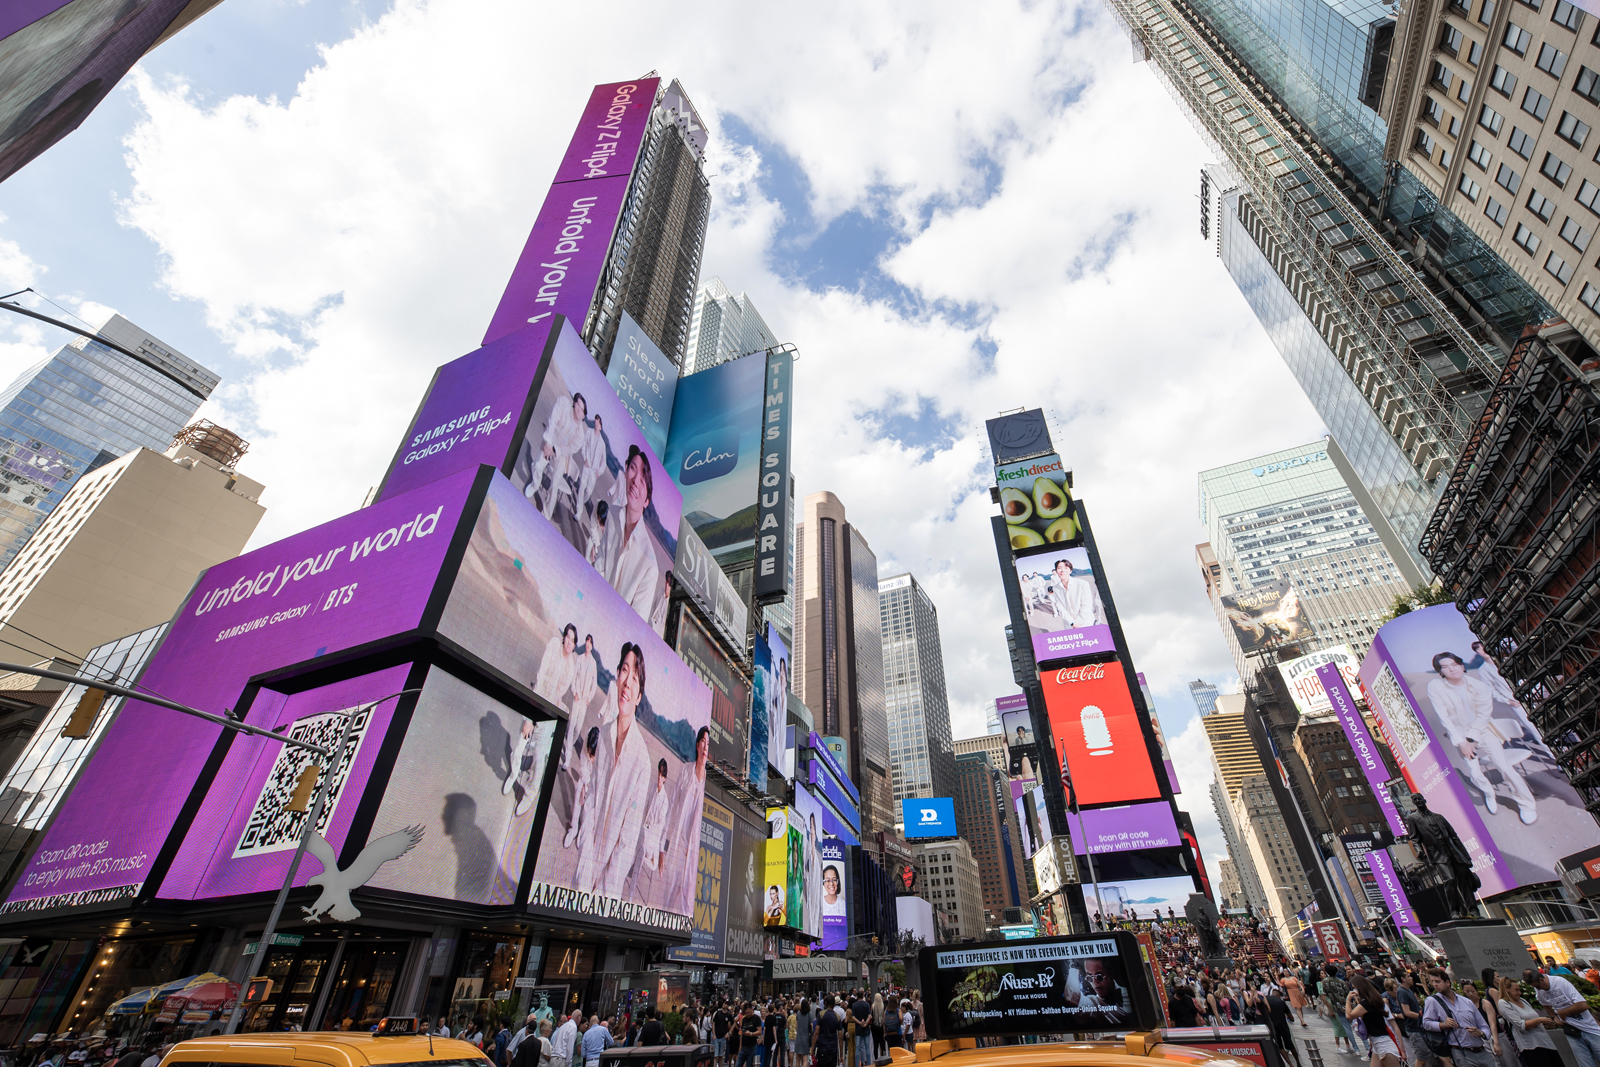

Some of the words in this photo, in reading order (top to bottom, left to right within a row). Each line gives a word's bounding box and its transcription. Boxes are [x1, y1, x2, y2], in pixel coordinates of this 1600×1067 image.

[600, 84, 637, 131] Galaxy
[598, 130, 621, 142] Z
[583, 143, 616, 178] Flip4
[554, 196, 598, 255] Unfold
[535, 257, 570, 305] your
[628, 335, 665, 381] Sleep
[624, 353, 662, 399] more.
[618, 374, 660, 423] Stress
[766, 361, 784, 441] TIMES
[404, 436, 457, 466] Galaxy
[459, 427, 476, 442] Z
[473, 411, 512, 437] Flip4
[411, 405, 491, 448] SAMSUNG
[683, 446, 736, 471] Calm
[1266, 450, 1327, 475] BARCLAYS
[760, 452, 781, 577] SQUARE
[195, 564, 281, 617] Unfold
[272, 545, 347, 598] your
[349, 505, 444, 563] world
[682, 534, 714, 601] SIX
[215, 614, 270, 643] SAMSUNG
[269, 602, 312, 626] Galaxy
[322, 582, 358, 612] BTS
[1237, 595, 1258, 611] Harry
[1257, 589, 1281, 606] Potter
[1047, 633, 1084, 644] SAMSUNG
[1049, 641, 1076, 651] Galaxy
[1081, 638, 1099, 648] Flip4
[1288, 657, 1320, 679] LITTLE
[1322, 653, 1349, 664] SHOP
[1330, 686, 1349, 715] world
[1345, 712, 1363, 738] your
[1363, 690, 1382, 724] COME
[1380, 724, 1406, 769] INSIDE!
[1354, 736, 1377, 770] Unfold
[1094, 843, 1113, 853] enjoy
[1115, 841, 1131, 850] with
[1132, 840, 1145, 848] BTS
[1146, 837, 1169, 846] music
[1118, 832, 1128, 840] QR
[1130, 831, 1149, 839] code
[1345, 840, 1372, 849] EVERY
[36, 849, 64, 866] Scan
[64, 843, 81, 860] QR
[79, 839, 109, 858] code
[1059, 838, 1076, 881] HELLO!
[24, 871, 37, 887] to
[36, 866, 67, 888] enjoy
[65, 861, 91, 880] with
[89, 857, 112, 876] BTS
[108, 851, 147, 872] music
[1382, 872, 1397, 894] your
[532, 882, 608, 918] AMERICAN
[609, 898, 642, 922] EAGLE
[643, 907, 693, 933] OUTFITTERS
[1390, 893, 1408, 923] Unfold
[276, 935, 302, 947] Broadway
[727, 928, 764, 956] CHICAGO
[966, 951, 1001, 964] EXPERIENCE
[1001, 951, 1009, 961] IS
[1009, 950, 1024, 960] NOW
[1025, 949, 1038, 959] FOR
[1039, 946, 1069, 958] EVERYONE
[1071, 946, 1079, 955] IN
[1080, 945, 1095, 954] NEW
[1096, 943, 1115, 954] YORK
[1320, 925, 1340, 955] tkts
[1482, 948, 1512, 957] GEORGE
[774, 961, 832, 975] SWAROVSKI
[971, 1010, 1003, 1019] Meatpacking
[1098, 1004, 1118, 1014] Square
[390, 1020, 409, 1033] 2A48
